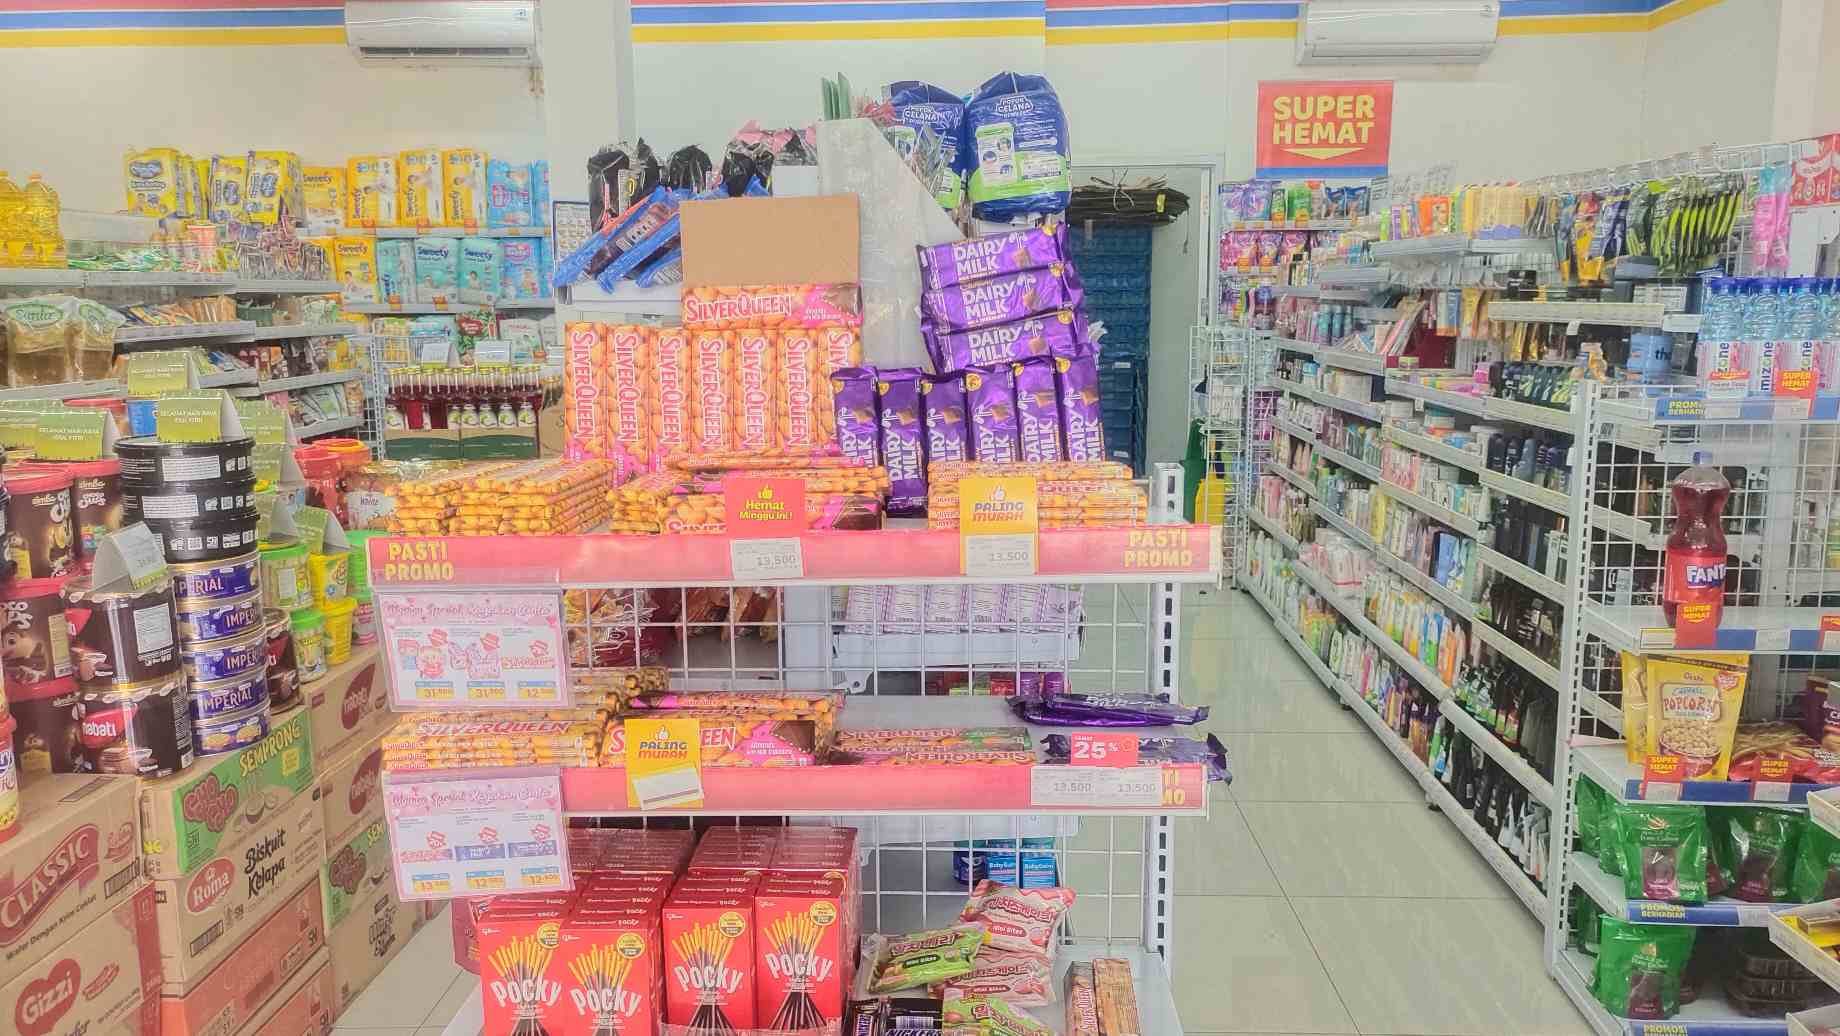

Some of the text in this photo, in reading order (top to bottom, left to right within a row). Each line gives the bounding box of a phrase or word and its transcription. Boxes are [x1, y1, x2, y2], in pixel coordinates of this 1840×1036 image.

[999, 103, 1031, 113] CELANA
[1273, 95, 1376, 121] SUPER
[1273, 122, 1375, 145] HEMAT
[418, 247, 449, 259] Sweety
[953, 237, 1007, 261] DAIRY
[956, 256, 1002, 276] MILK
[962, 280, 1015, 306] DAIRY
[965, 300, 1010, 320] MILK
[968, 324, 1022, 348] DAIRY
[971, 343, 1016, 365] MILK
[1760, 341, 1774, 392] mizone
[1784, 371, 1811, 379] SUPER
[1020, 411, 1039, 464] DAIRY
[1038, 420, 1057, 463] MILK
[1068, 410, 1088, 462] DAIRY
[1085, 419, 1103, 462] MILK
[883, 428, 902, 482] DAIRY
[900, 437, 920, 480] MILK
[746, 500, 784, 510] Hemat
[1129, 529, 1187, 548] PASTI
[388, 543, 448, 561] PASTI
[1123, 550, 1193, 568] PROMO
[384, 563, 454, 582] PROMO
[1686, 564, 1726, 583] FANT
[226, 608, 256, 629] IMPER
[226, 651, 256, 672] IMPER
[239, 717, 303, 778] SEMPRONG
[244, 828, 287, 874] Biskuit
[1, 833, 91, 929] CLASSIC
[191, 873, 231, 908] Roma
[248, 857, 287, 900] Kelapa
[674, 964, 744, 994] POCKY
[765, 953, 833, 982] POCKY
[490, 979, 562, 1007] POCKY
[570, 988, 642, 1017] POCKY
